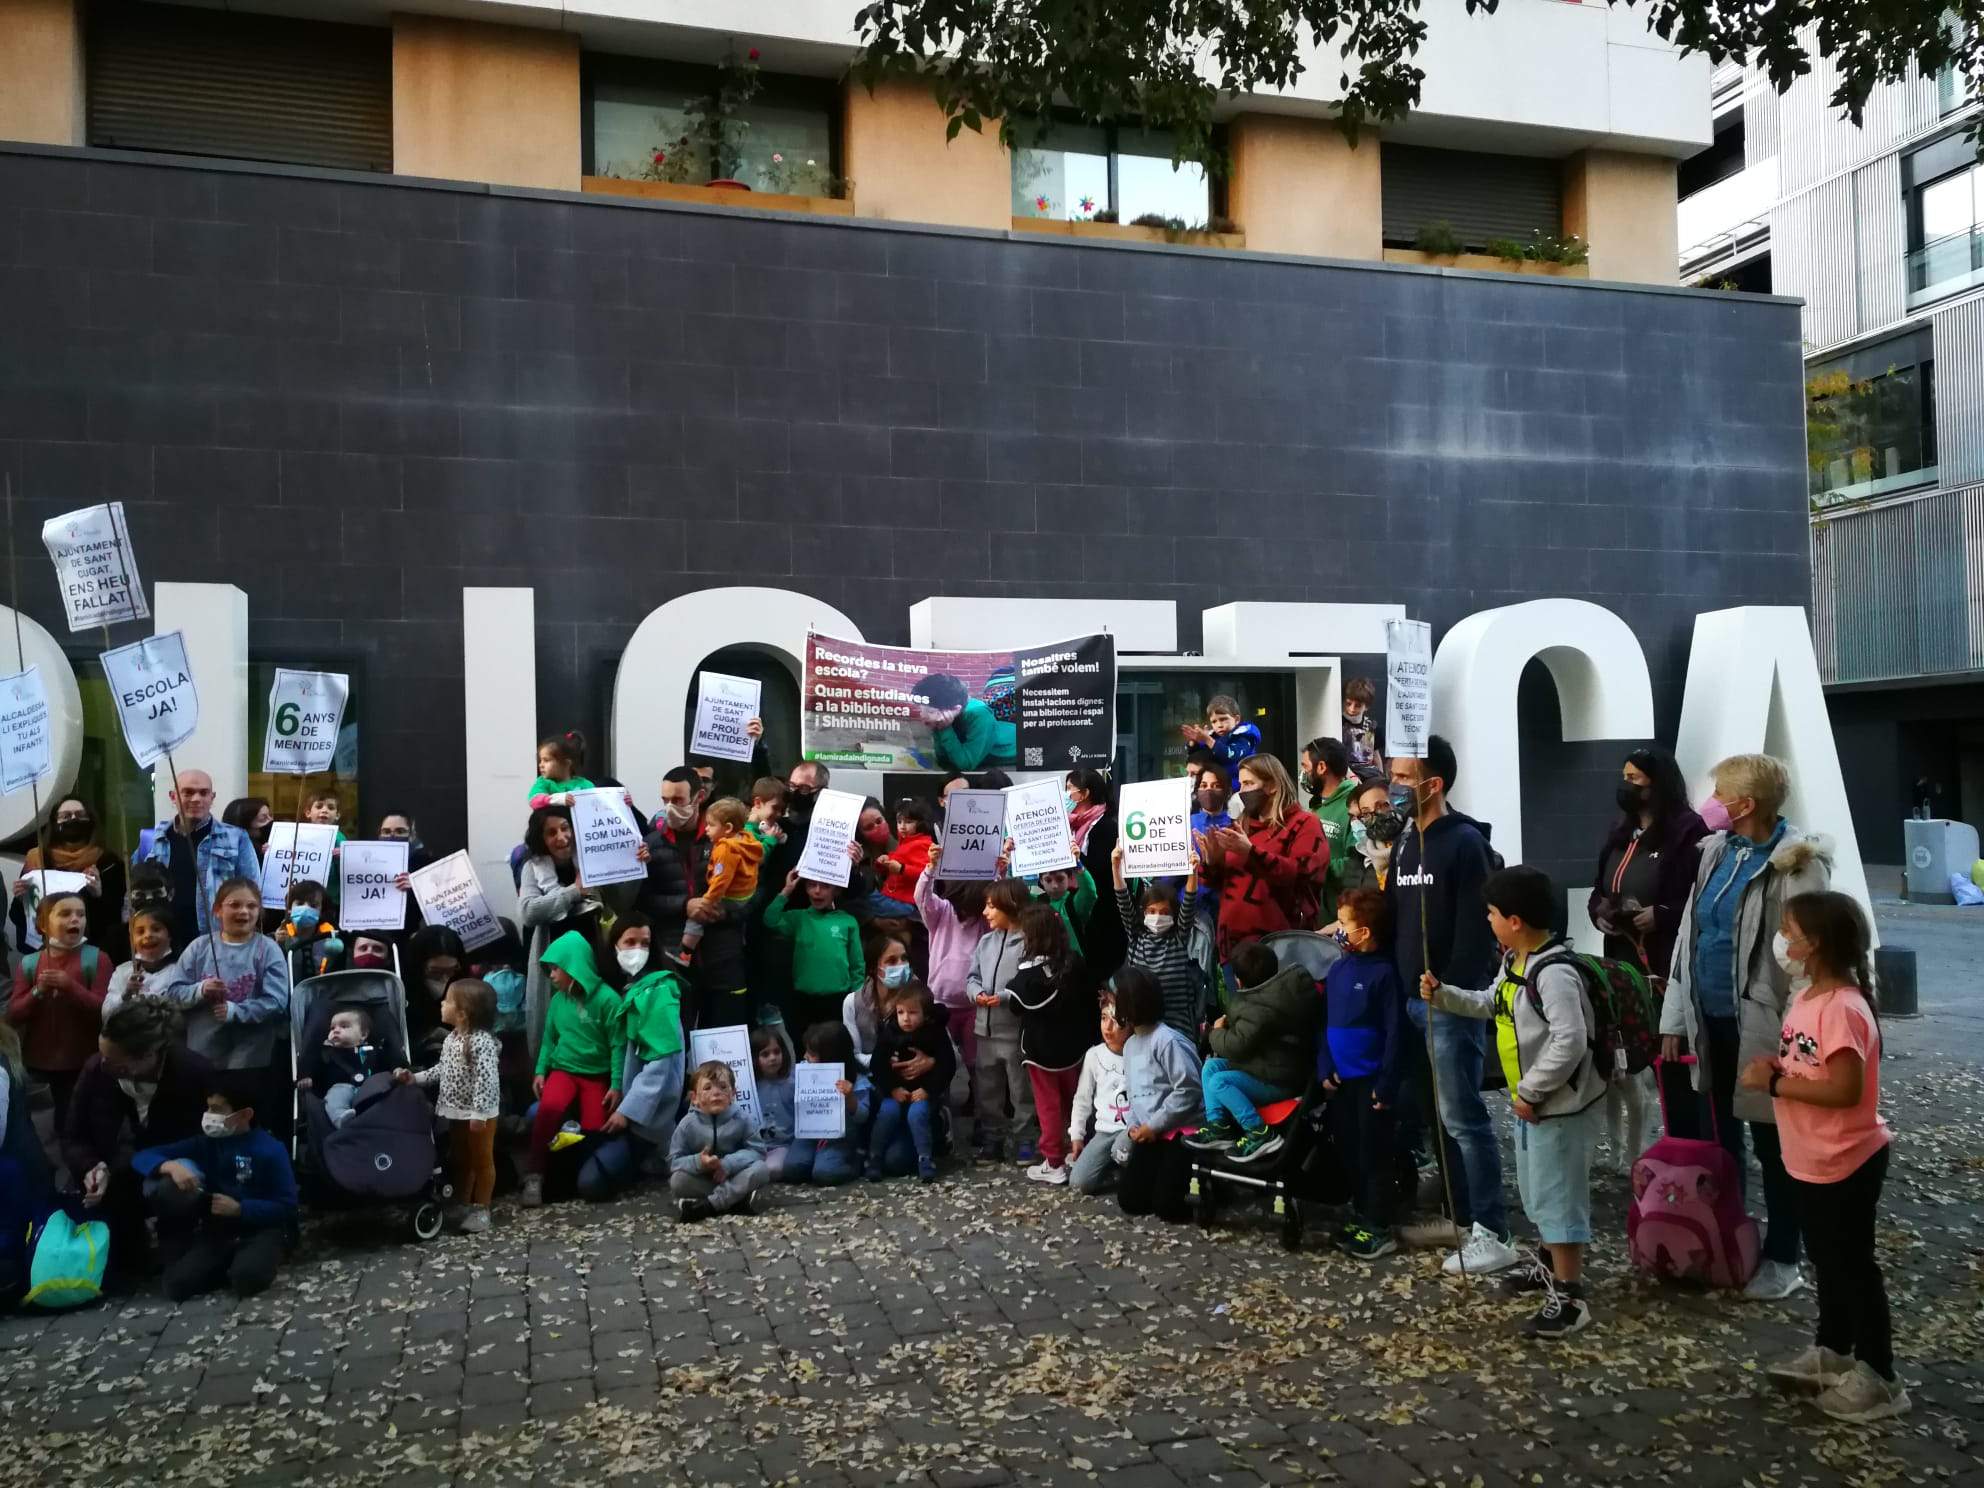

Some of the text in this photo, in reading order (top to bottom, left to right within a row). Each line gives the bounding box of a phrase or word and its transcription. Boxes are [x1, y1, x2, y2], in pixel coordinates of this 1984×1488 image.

[71, 552, 113, 568] DE SANT
[69, 574, 130, 596] ENS HEU
[815, 647, 928, 674] Recordes la teva
[1021, 652, 1077, 668] Nosaltres
[815, 665, 868, 679] escola?
[1021, 662, 1099, 676] també volem!
[122, 672, 190, 707] ESCOLA
[815, 684, 930, 704] Quan estudiaves
[1022, 688, 1069, 696] Necessitem
[148, 697, 178, 720] JA!
[704, 696, 754, 710] AJUNTAMENT
[815, 700, 910, 716] a la biblioteca
[712, 705, 745, 717] DE SANT
[1022, 709, 1038, 717] una
[1039, 708, 1078, 717] biblioteca
[1083, 707, 1104, 717] espai
[275, 702, 335, 736] 6 ANYS
[1023, 718, 1094, 729] per al professorat.
[301, 726, 318, 737] DE
[711, 723, 740, 735] PROU
[274, 739, 332, 751] MENTIDES
[699, 730, 749, 746] MENTIDES
[591, 816, 622, 827] JA NO
[1126, 811, 1183, 840] 6 ANYS
[584, 827, 633, 841] SOM UNA
[950, 824, 1000, 835] ESCOLA
[1149, 828, 1166, 838] DE
[584, 839, 636, 854] PRIORITAT?
[961, 839, 985, 851] JA!
[1128, 842, 1186, 853] MENTIDES
[281, 864, 310, 874] NOU
[1397, 864, 1434, 886] benetn
[361, 887, 385, 899] JA!
[436, 892, 468, 911] DE SANT
[445, 911, 475, 928] PROU
[457, 914, 492, 935] TIDES
[735, 1090, 751, 1101] EU
